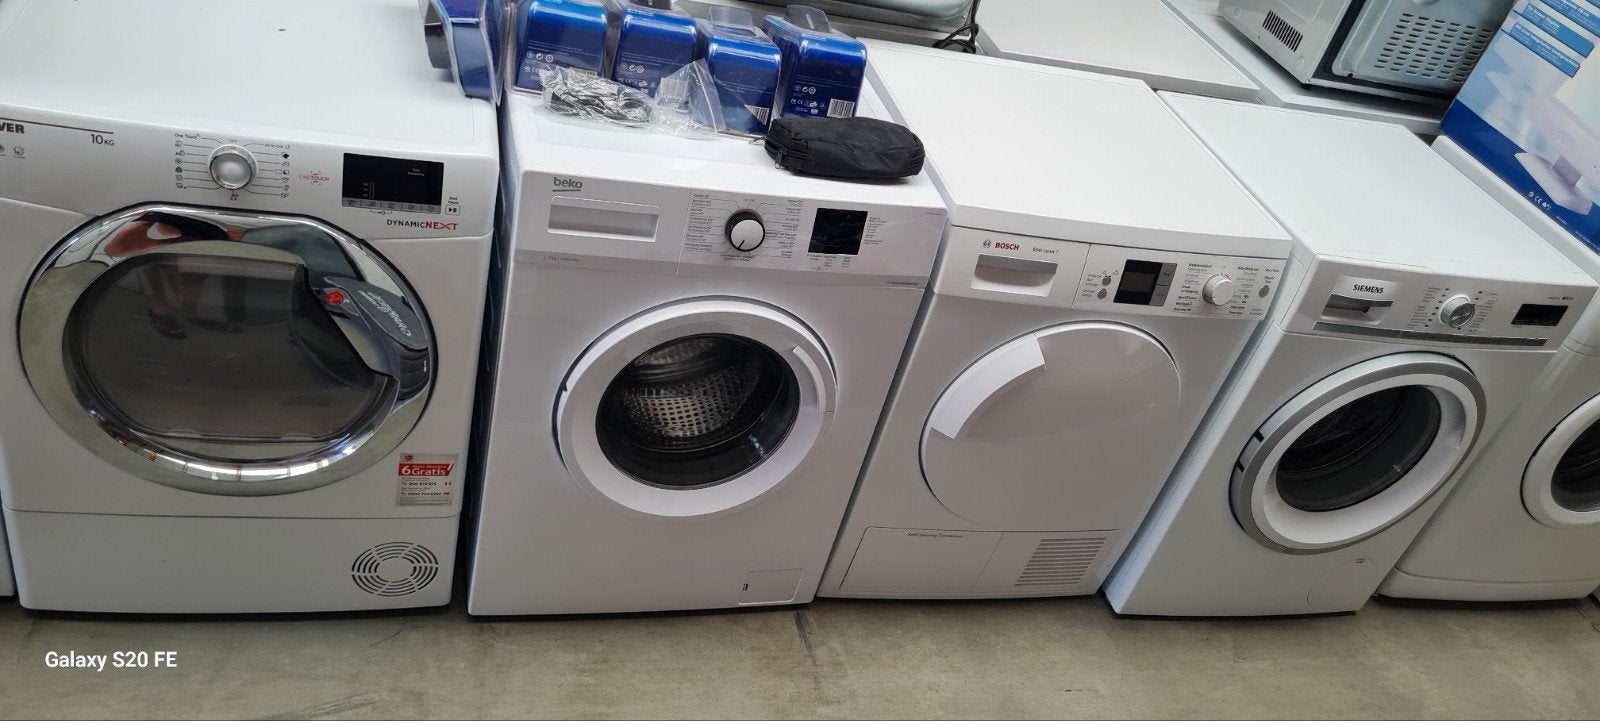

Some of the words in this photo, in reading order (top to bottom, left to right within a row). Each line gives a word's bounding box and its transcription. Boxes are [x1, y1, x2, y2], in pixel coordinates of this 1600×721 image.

[553, 176, 583, 189] beko
[995, 242, 1020, 251] BOSCH
[1353, 284, 1384, 294] SIEMENS
[411, 467, 446, 476] Gratis
